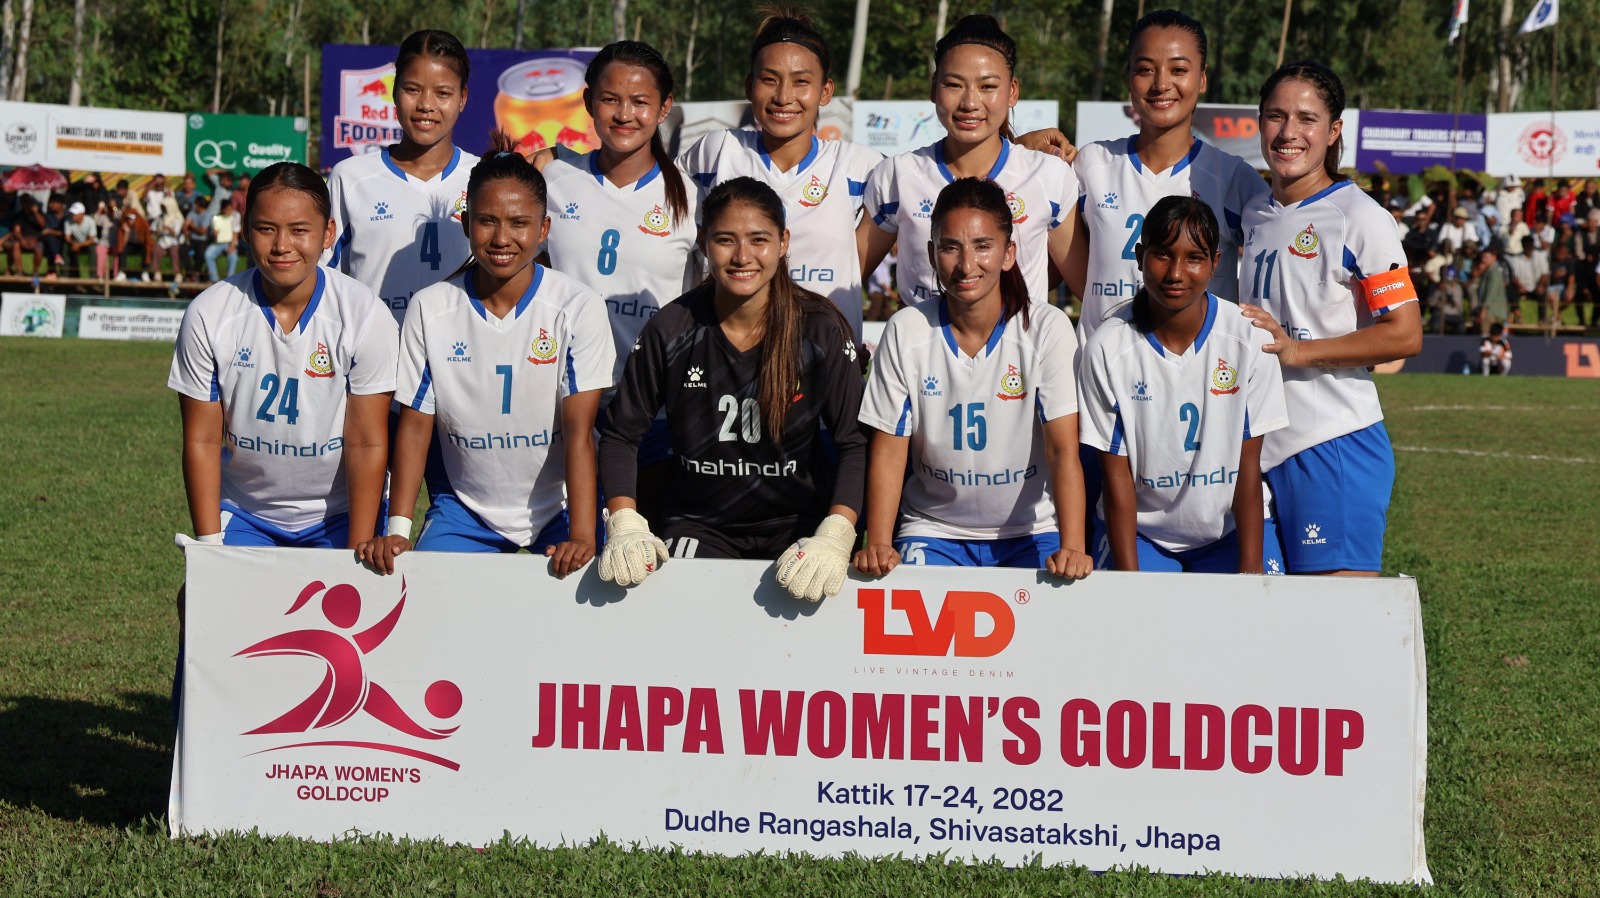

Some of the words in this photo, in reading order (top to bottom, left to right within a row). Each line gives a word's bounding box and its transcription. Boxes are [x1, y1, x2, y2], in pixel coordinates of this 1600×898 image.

[362, 105, 388, 119] Red
[140, 131, 164, 142] HOUSE
[248, 143, 292, 158] Quality
[194, 140, 237, 169] QC
[370, 214, 394, 222] KELME
[559, 213, 580, 221] KELME
[421, 222, 441, 270] 4
[597, 229, 620, 276] 8
[1253, 249, 1278, 299] 11
[1371, 281, 1405, 297] CAPTAIN
[233, 361, 255, 369] KELME
[256, 373, 299, 425] 24
[496, 365, 513, 414] 7
[920, 389, 943, 397] KELME
[718, 394, 761, 443] 20
[948, 402, 987, 451] 15
[1179, 402, 1200, 451] 2
[227, 430, 344, 457] mahindra
[919, 463, 1037, 486] mahindra
[857, 588, 1015, 657] LVD
[854, 666, 886, 674] LIVE
[896, 668, 958, 676] VINTAGE
[532, 682, 724, 754] JHAPA
[739, 689, 1041, 765] WOMEN’S
[1060, 698, 1364, 776] GOLDCUP
[265, 764, 328, 780] JHAPA
[335, 766, 421, 783] WOMEN'S
[297, 785, 389, 802] GOLDCUP
[818, 782, 895, 806] Kattik
[903, 785, 984, 813] 17-24,
[993, 787, 1063, 812] 2082
[665, 808, 750, 833] Dudhe
[759, 812, 920, 844] Rangashala,
[929, 818, 1126, 852] Shivasatakshi,
[1136, 826, 1221, 855] Jhapa
